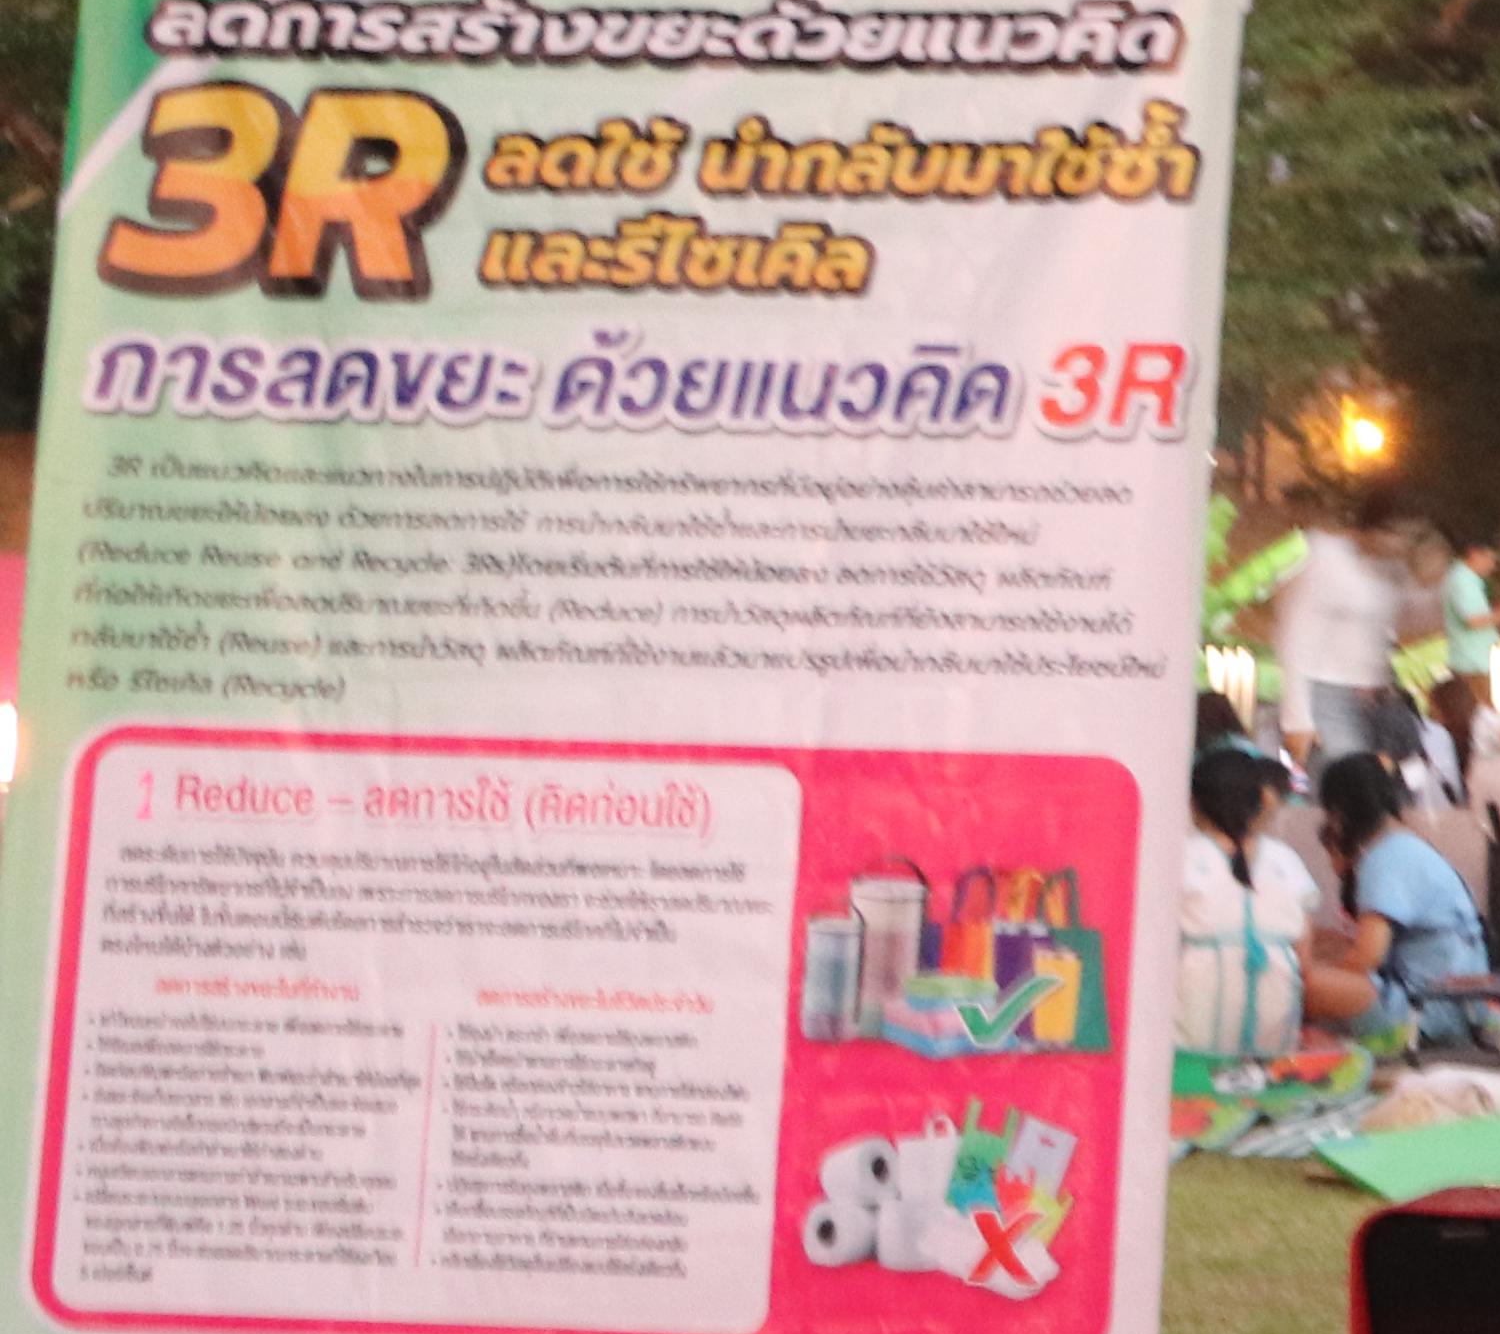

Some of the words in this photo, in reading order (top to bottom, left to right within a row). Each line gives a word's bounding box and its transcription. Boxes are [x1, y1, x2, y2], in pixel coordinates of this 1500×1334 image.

[98, 79, 468, 299] 3R
[482, 116, 684, 196] ลดใช้
[696, 99, 1201, 204] นำกลับมาใช้ซ้ำ
[479, 211, 874, 295] และรีไซเคิล
[86, 332, 537, 418] การลดขยะ
[550, 330, 1018, 432] ด้วยแนวคิด
[1037, 339, 1190, 435] 3R
[174, 775, 315, 819] Reduce
[363, 777, 512, 824] ลดการใช้
